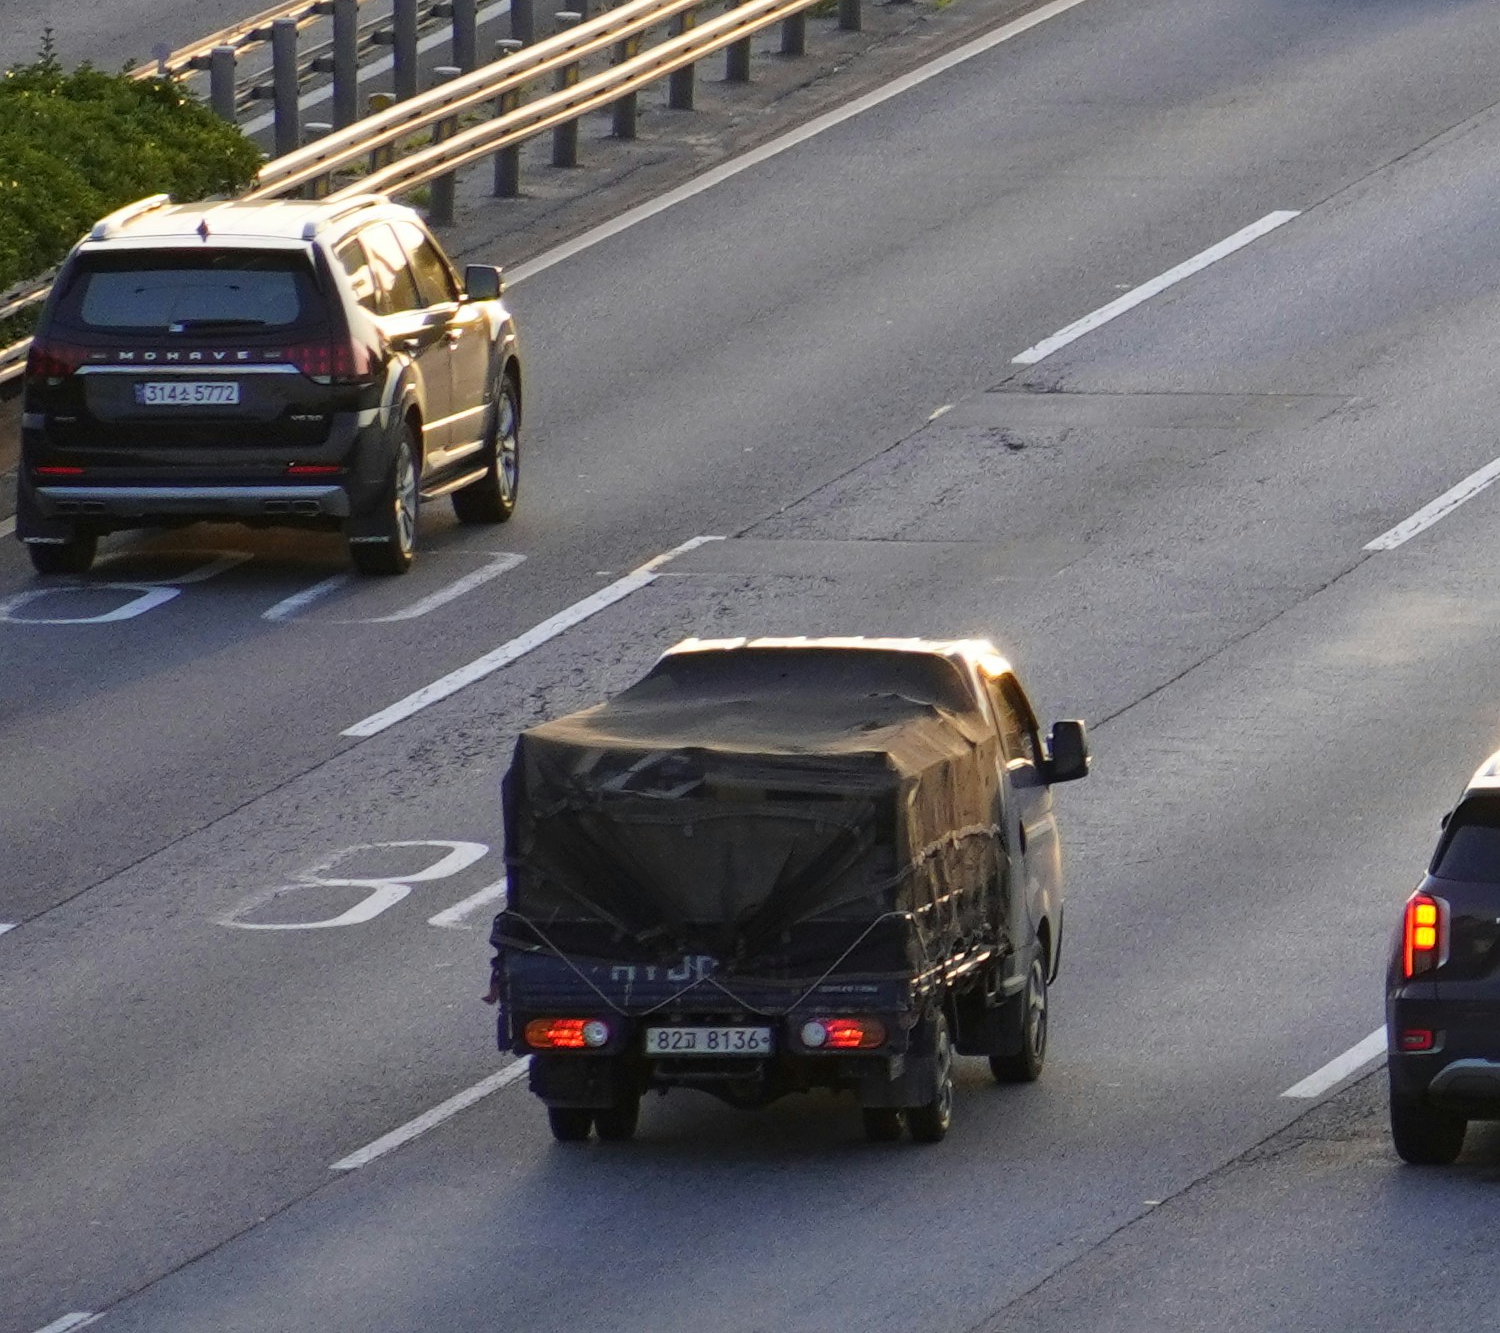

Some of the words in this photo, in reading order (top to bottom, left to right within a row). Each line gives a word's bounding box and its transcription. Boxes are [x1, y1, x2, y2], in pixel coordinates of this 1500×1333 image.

[118, 350, 249, 361] MOHAVE
[194, 384, 236, 402] 5772
[707, 1029, 759, 1050] 8136
